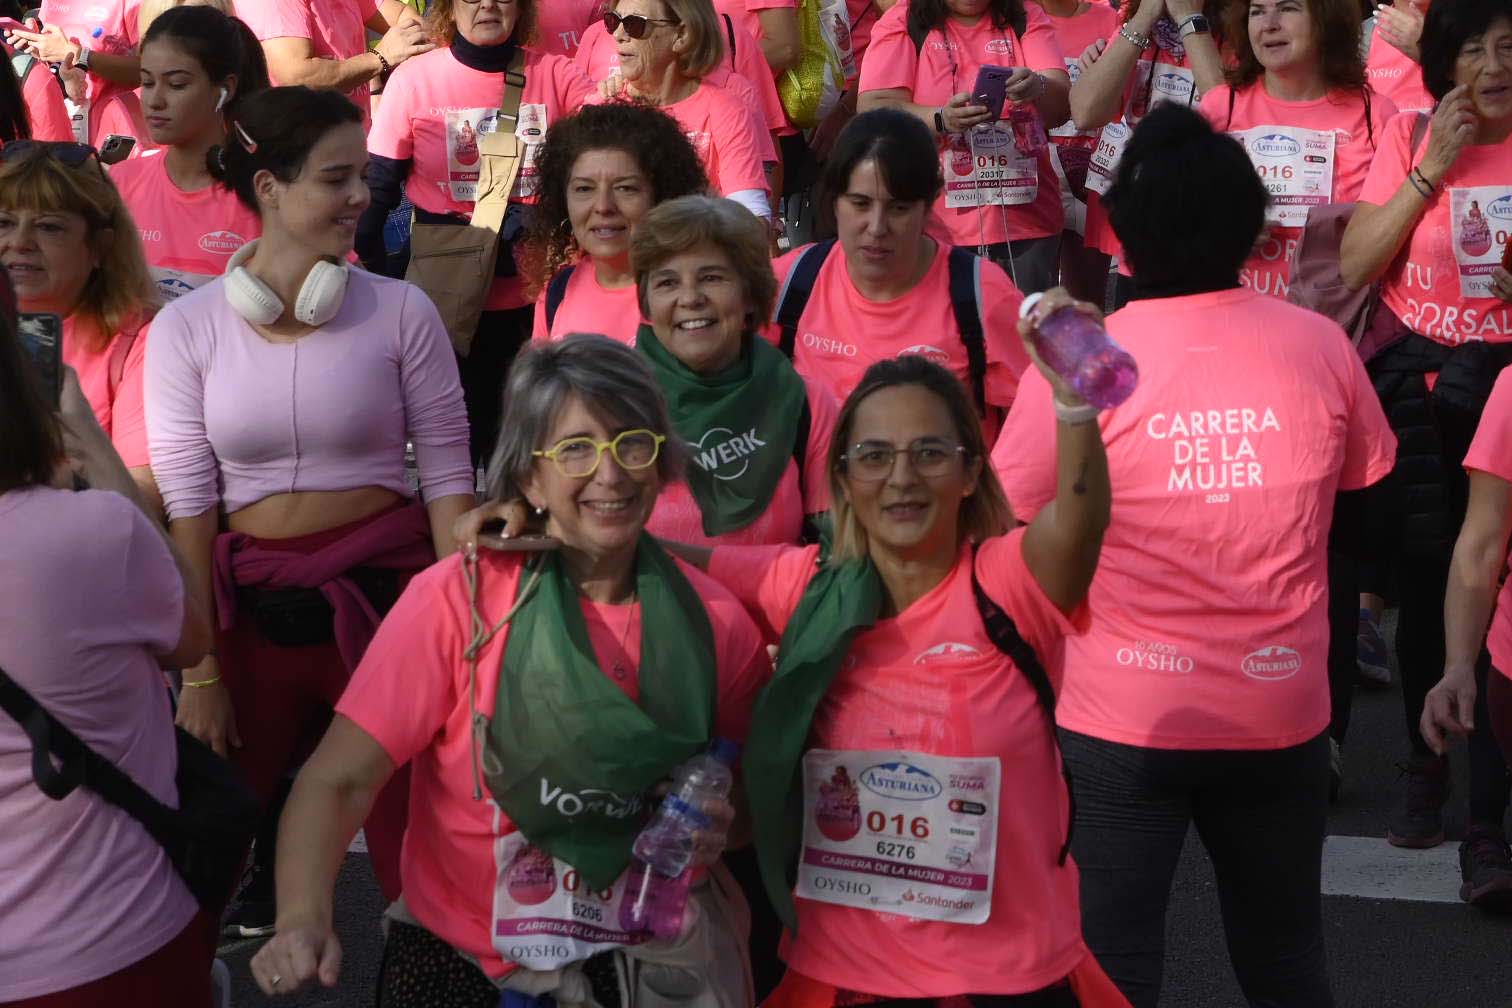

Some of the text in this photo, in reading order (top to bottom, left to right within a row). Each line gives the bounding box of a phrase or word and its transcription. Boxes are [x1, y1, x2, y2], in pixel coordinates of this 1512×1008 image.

[1098, 139, 1116, 157] 016
[977, 155, 1008, 168] 016
[1406, 262, 1431, 290] TU
[803, 332, 857, 357] OYSHO
[1147, 407, 1280, 439] CARRERA
[1174, 435, 1256, 465] DE LA
[1168, 463, 1263, 492] MUJER
[1206, 493, 1230, 503] 2023
[1116, 647, 1194, 673] OYSHO
[867, 772, 936, 794] ASTURIANA
[950, 780, 985, 791] SUMA
[866, 810, 930, 839] 016
[876, 841, 916, 860] 6276
[821, 854, 873, 870] CARRERA
[874, 862, 890, 872] DE
[891, 865, 905, 875] LA
[908, 868, 945, 882] MUJER
[814, 875, 872, 896] OYSHO
[917, 892, 976, 910] Santander
[516, 921, 568, 933] CARRERA
[510, 944, 569, 959] OYSHO
